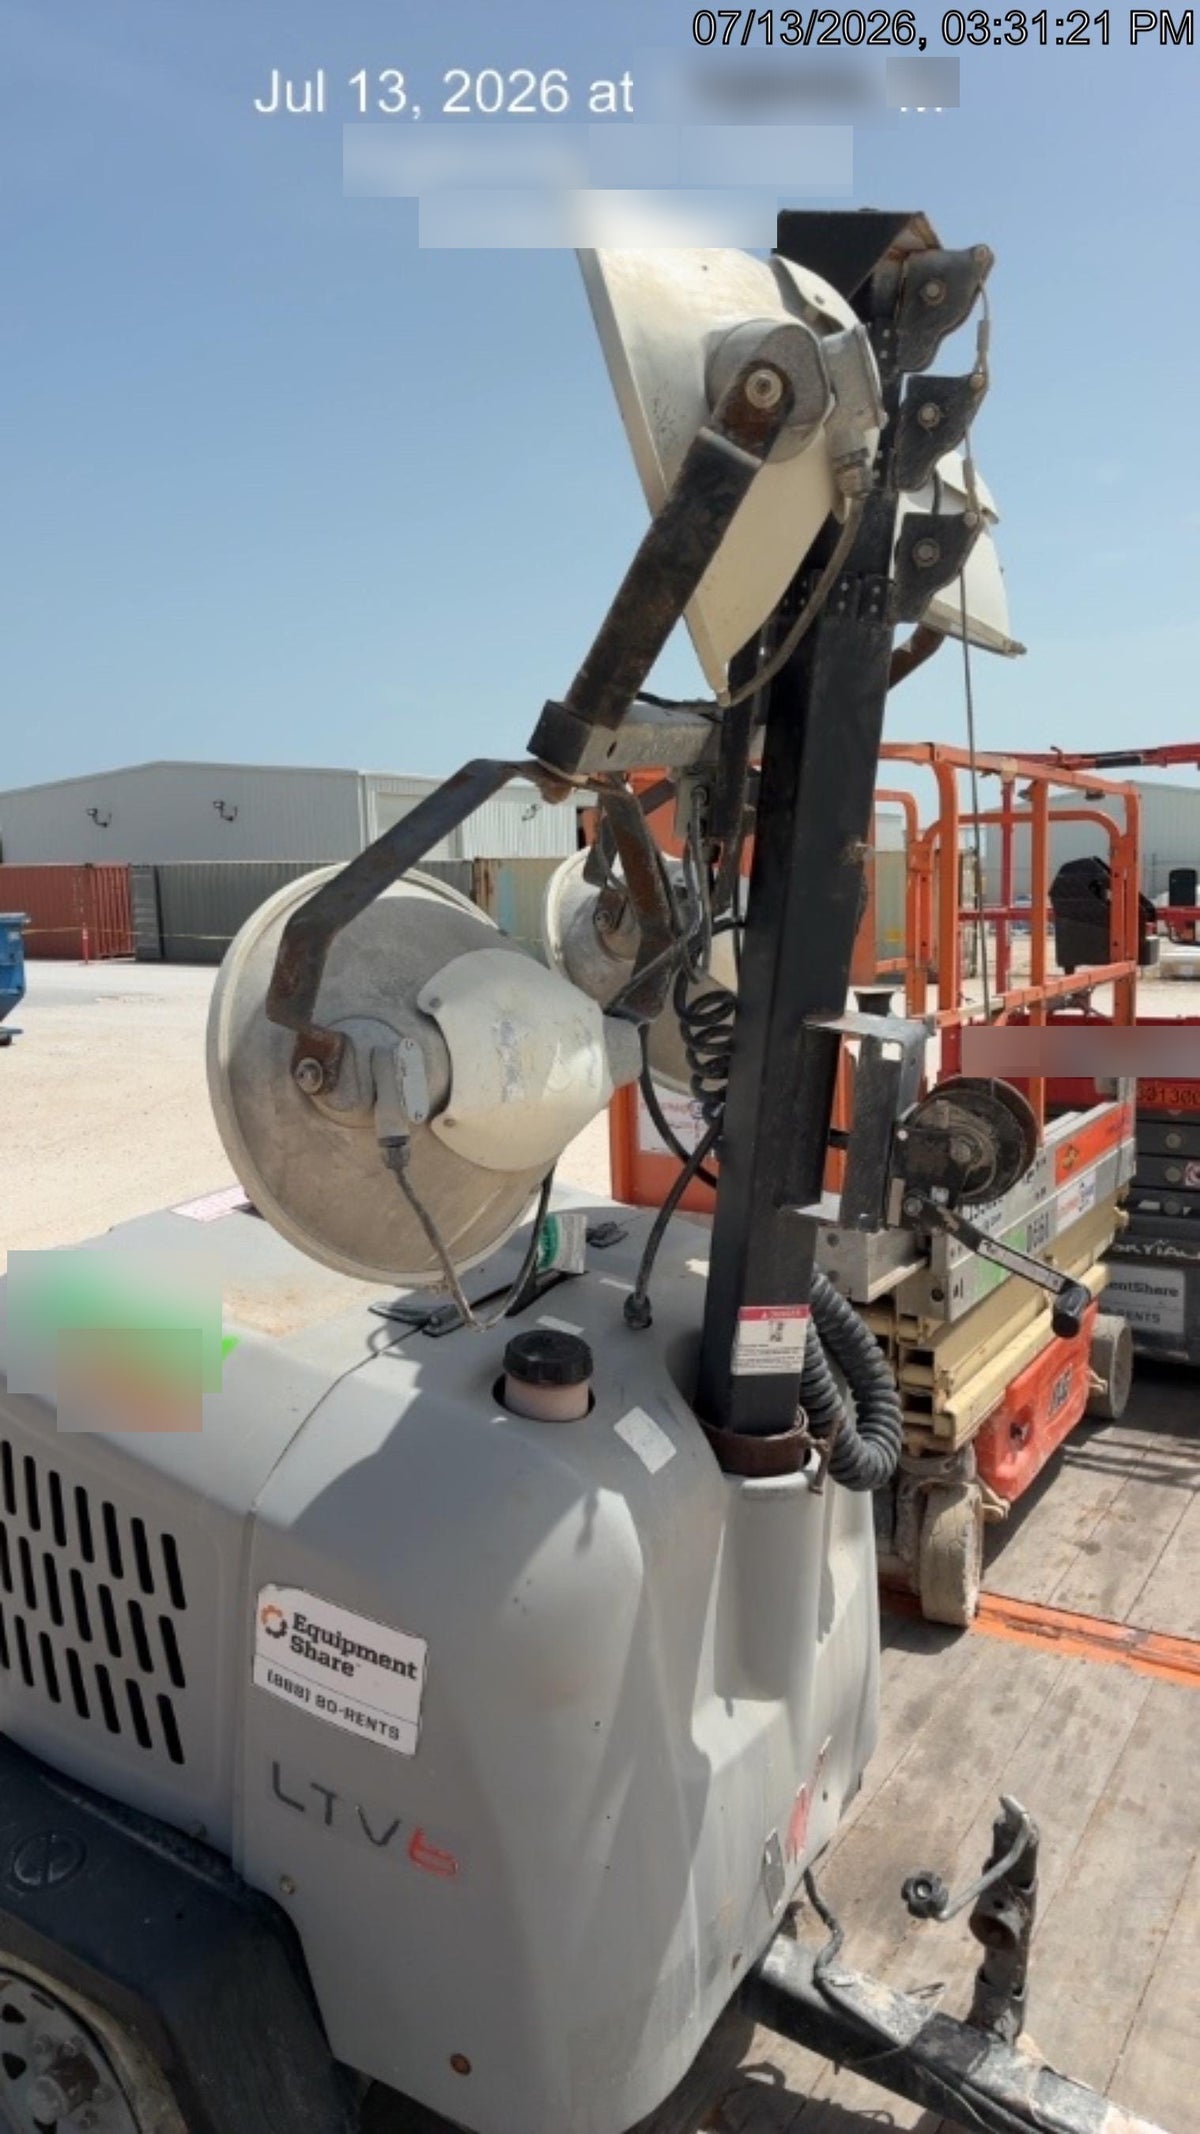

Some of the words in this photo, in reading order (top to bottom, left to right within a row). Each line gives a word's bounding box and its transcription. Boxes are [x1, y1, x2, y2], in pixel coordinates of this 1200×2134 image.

[289, 1634, 356, 1677] Share
[292, 1611, 418, 1680] Equipment
[266, 1668, 312, 1703] (888)
[314, 1694, 400, 1741] 80-RENTS
